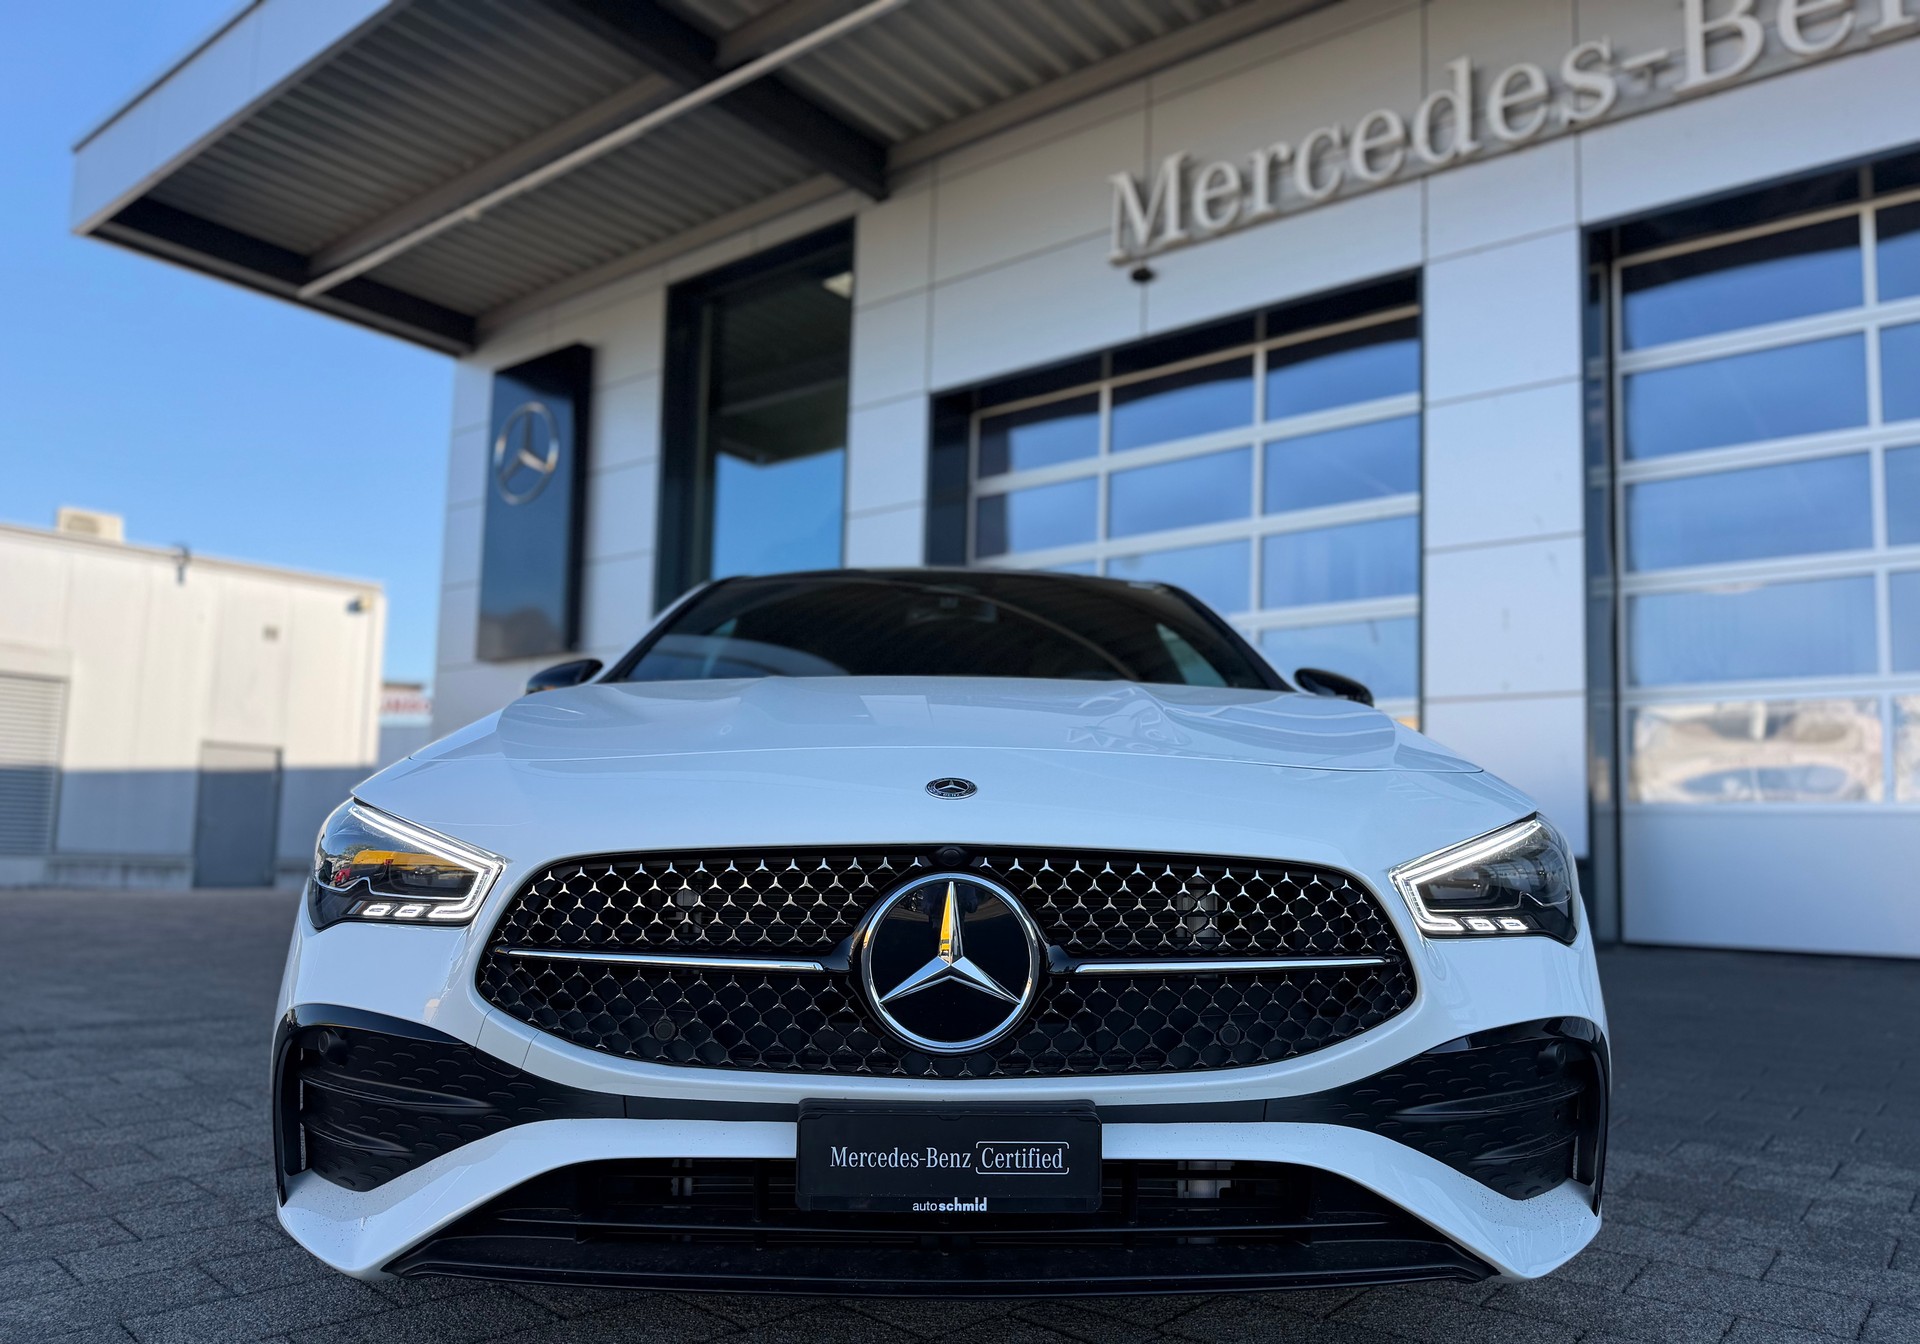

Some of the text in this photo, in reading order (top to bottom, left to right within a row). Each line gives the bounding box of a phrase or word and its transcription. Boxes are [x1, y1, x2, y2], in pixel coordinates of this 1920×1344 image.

[1106, 0, 1920, 264] Mercedes-Be
[829, 1146, 1064, 1169] Mercedes-Benz Certified
